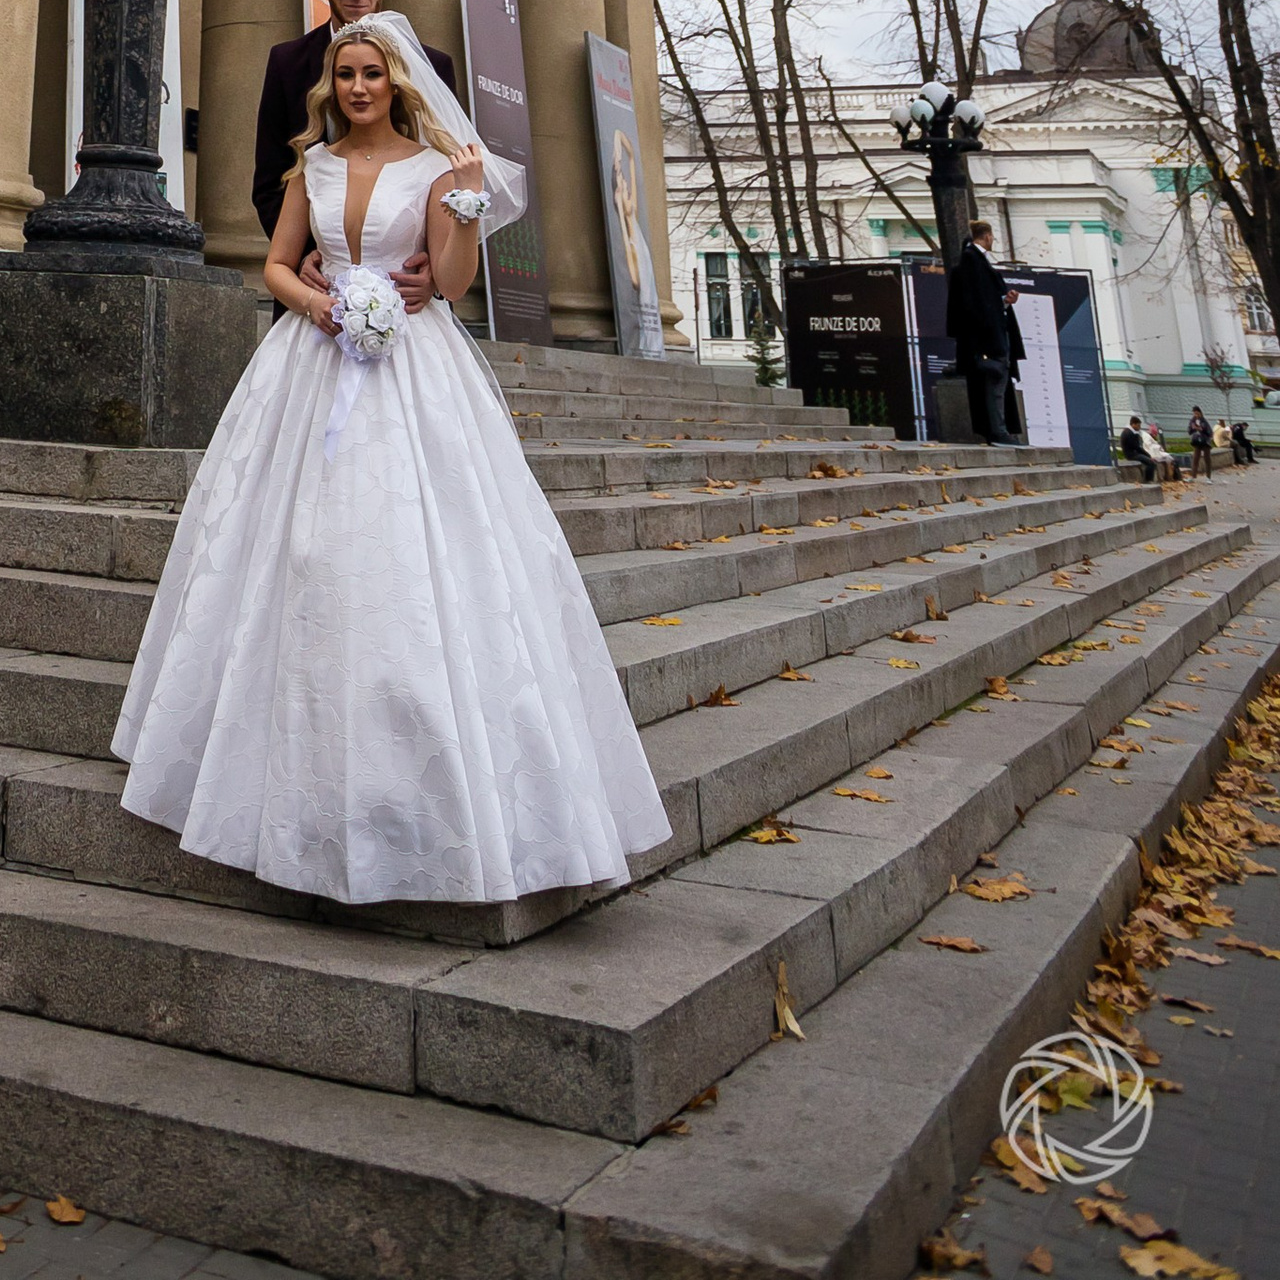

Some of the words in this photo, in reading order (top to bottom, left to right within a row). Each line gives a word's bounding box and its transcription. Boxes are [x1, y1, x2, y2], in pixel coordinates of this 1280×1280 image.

[477, 74, 501, 97] FRUNZE
[501, 84, 510, 100] DE
[510, 88, 524, 106] DOR
[809, 317, 843, 331] FRUNZE
[845, 317, 858, 331] DE
[860, 317, 881, 332] DOR
